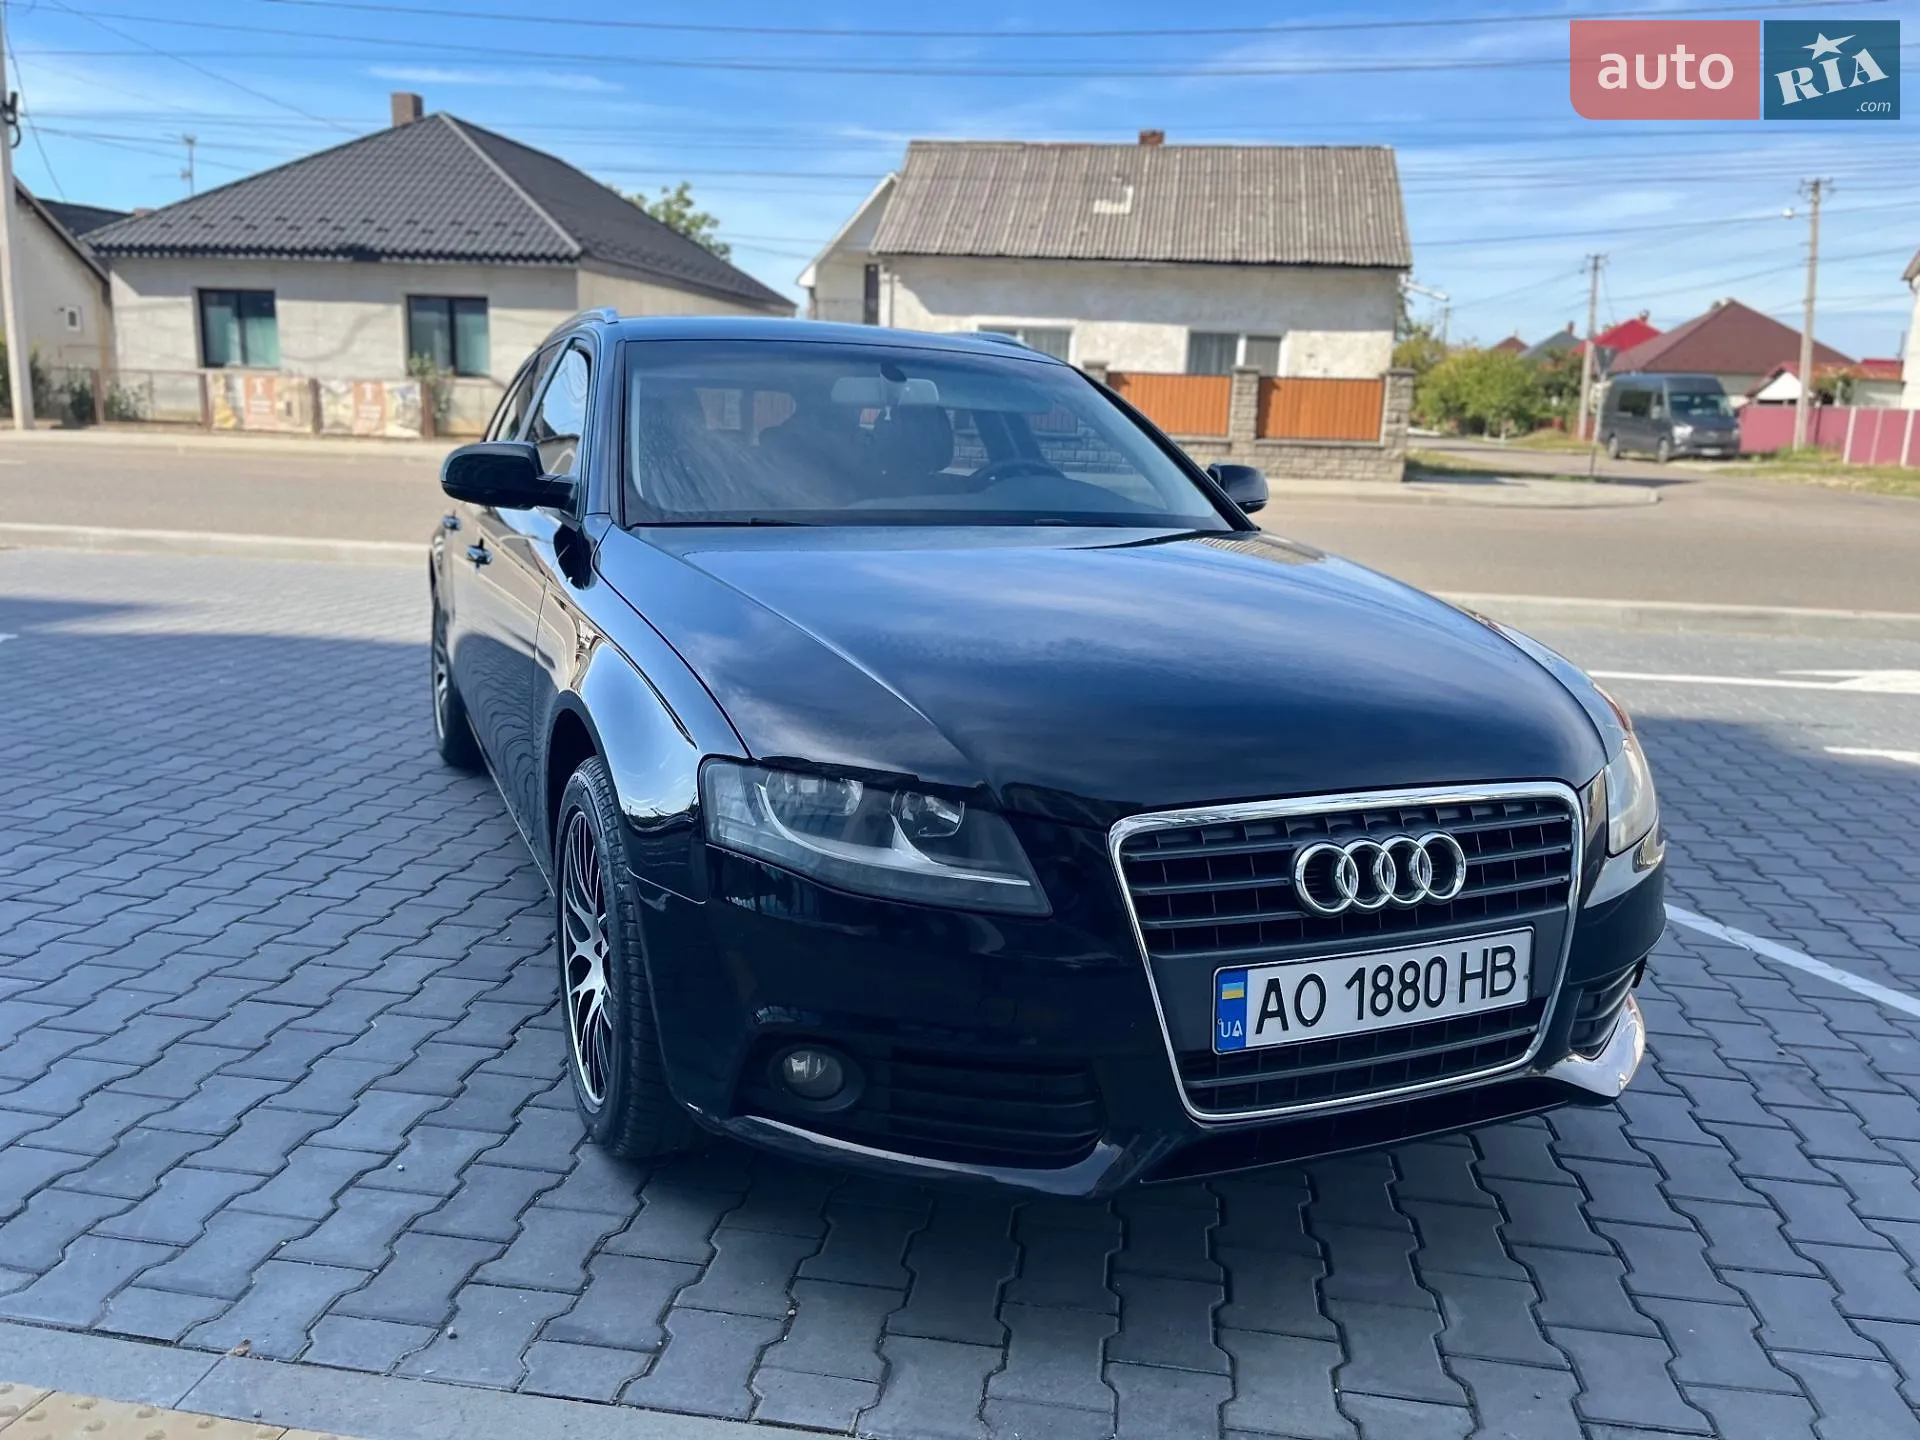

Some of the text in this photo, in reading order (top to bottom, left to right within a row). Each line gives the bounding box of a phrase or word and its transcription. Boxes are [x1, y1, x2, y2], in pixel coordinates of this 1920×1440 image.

[1255, 944, 1517, 1034] AO 1880 HB
[1220, 1019, 1243, 1038] UA
